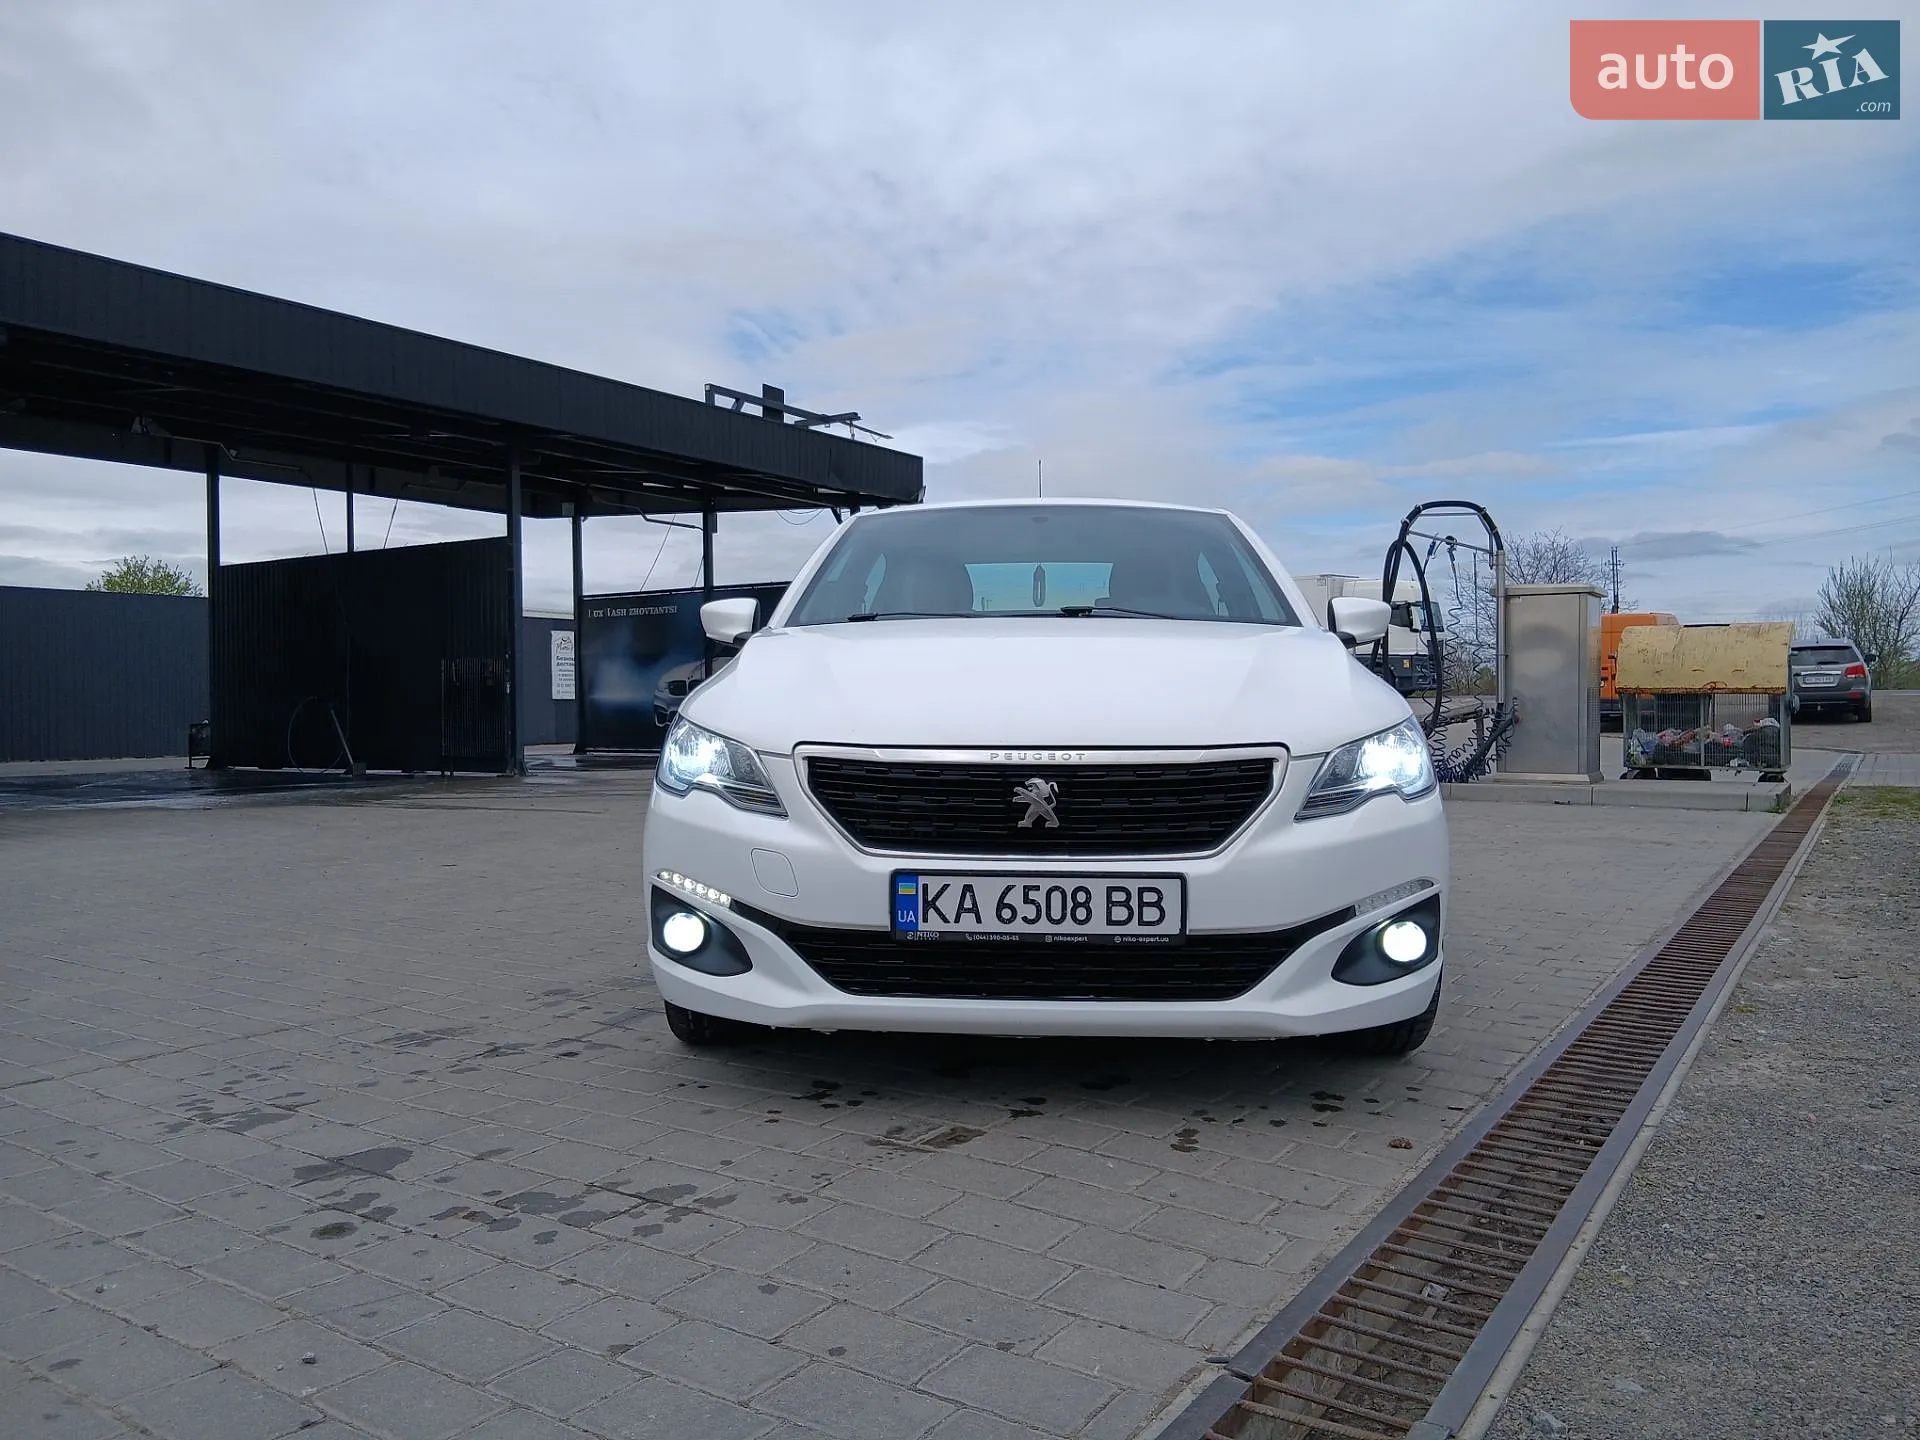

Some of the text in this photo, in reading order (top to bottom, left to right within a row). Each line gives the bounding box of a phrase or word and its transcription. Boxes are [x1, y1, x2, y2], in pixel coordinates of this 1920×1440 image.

[989, 752, 1086, 761] PEUGEOT
[921, 883, 1167, 927] KA 6508 BB
[897, 909, 917, 924] UA
